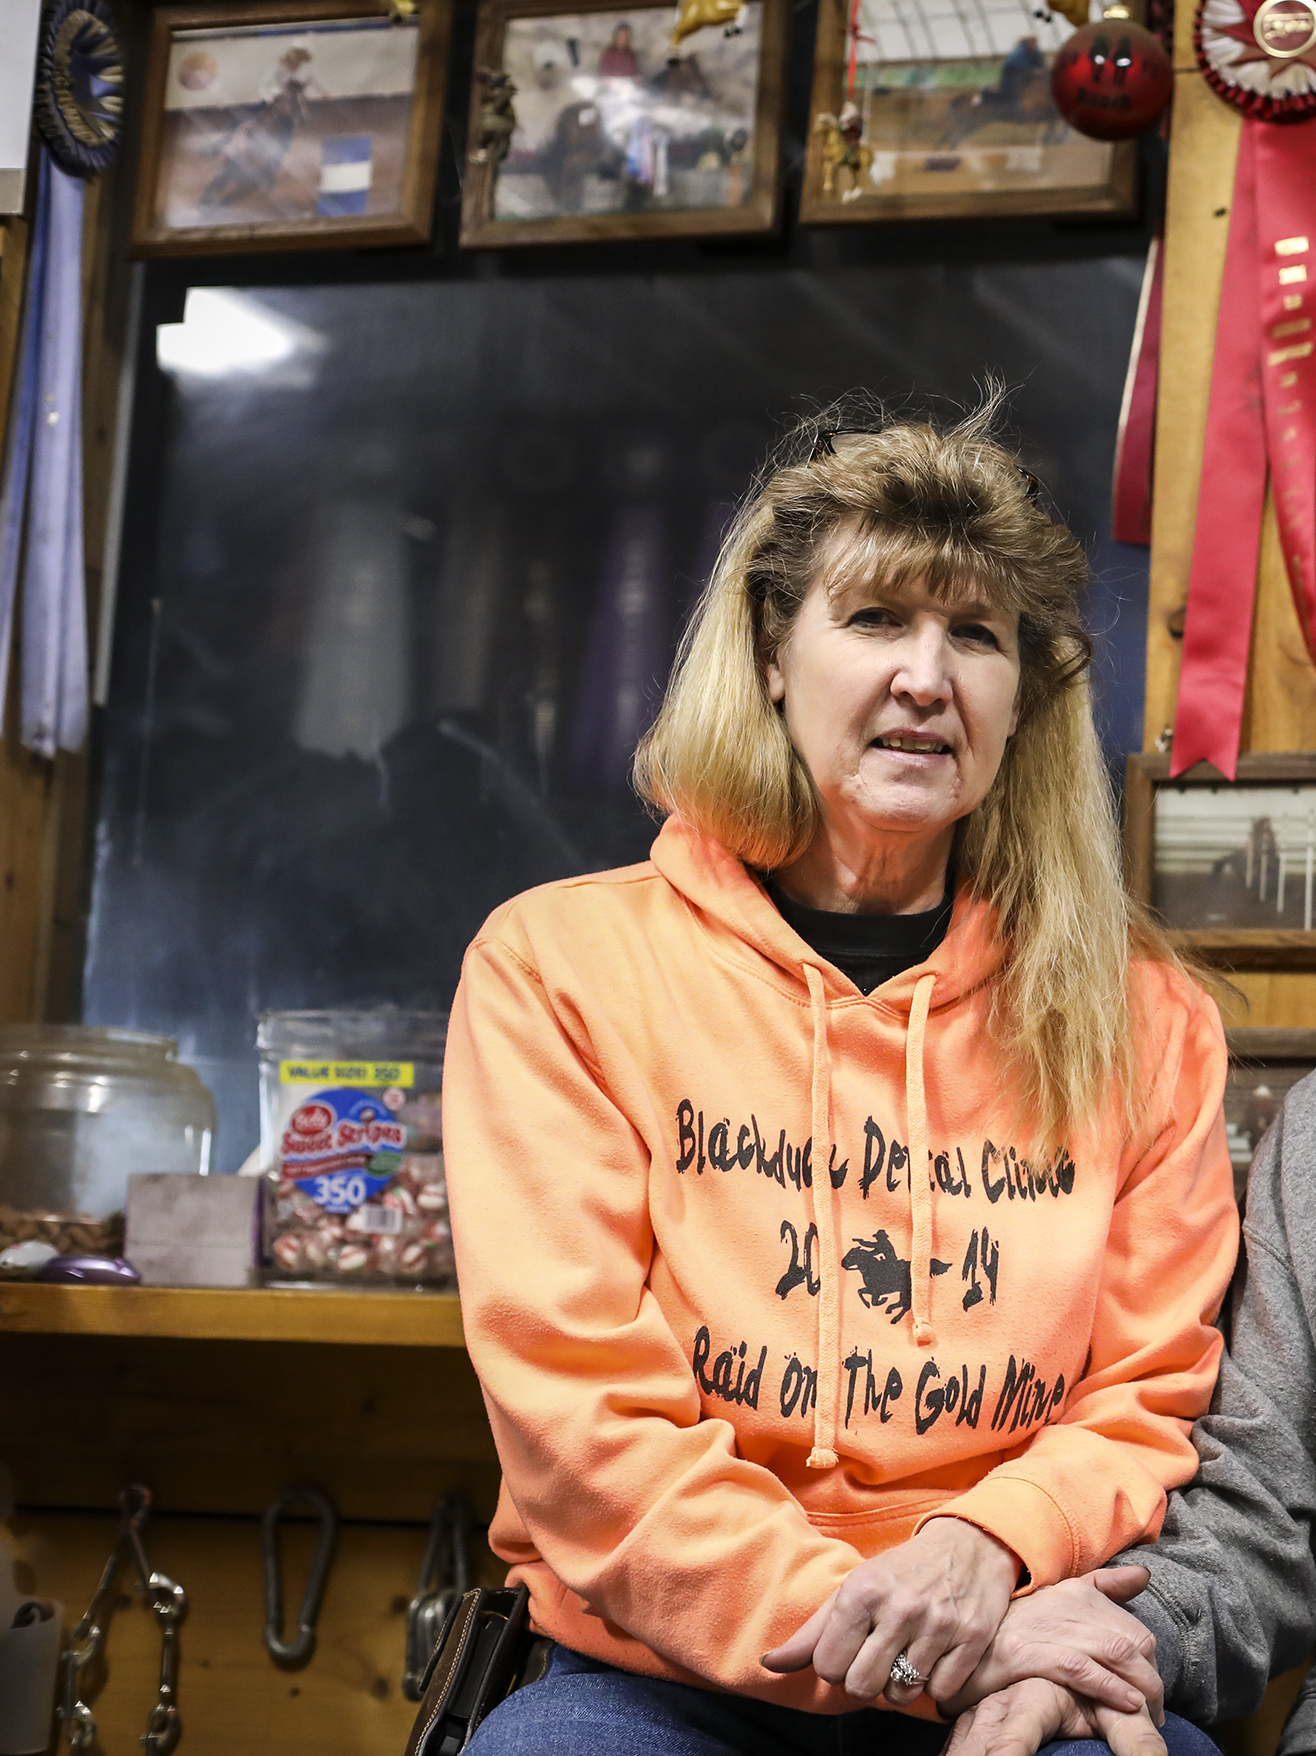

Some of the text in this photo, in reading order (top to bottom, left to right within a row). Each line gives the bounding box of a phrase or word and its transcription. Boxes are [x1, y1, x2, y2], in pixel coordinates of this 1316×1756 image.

[287, 1066, 329, 1079] VALUE
[282, 1119, 402, 1155] Sweet Stripes
[858, 1115, 972, 1199] Deal
[313, 1176, 367, 1205] 350
[775, 1220, 820, 1300] 20
[693, 1326, 767, 1410] Raid
[842, 1346, 902, 1429] The
[915, 1357, 986, 1434] Gold
[991, 1355, 1065, 1434] Mine
